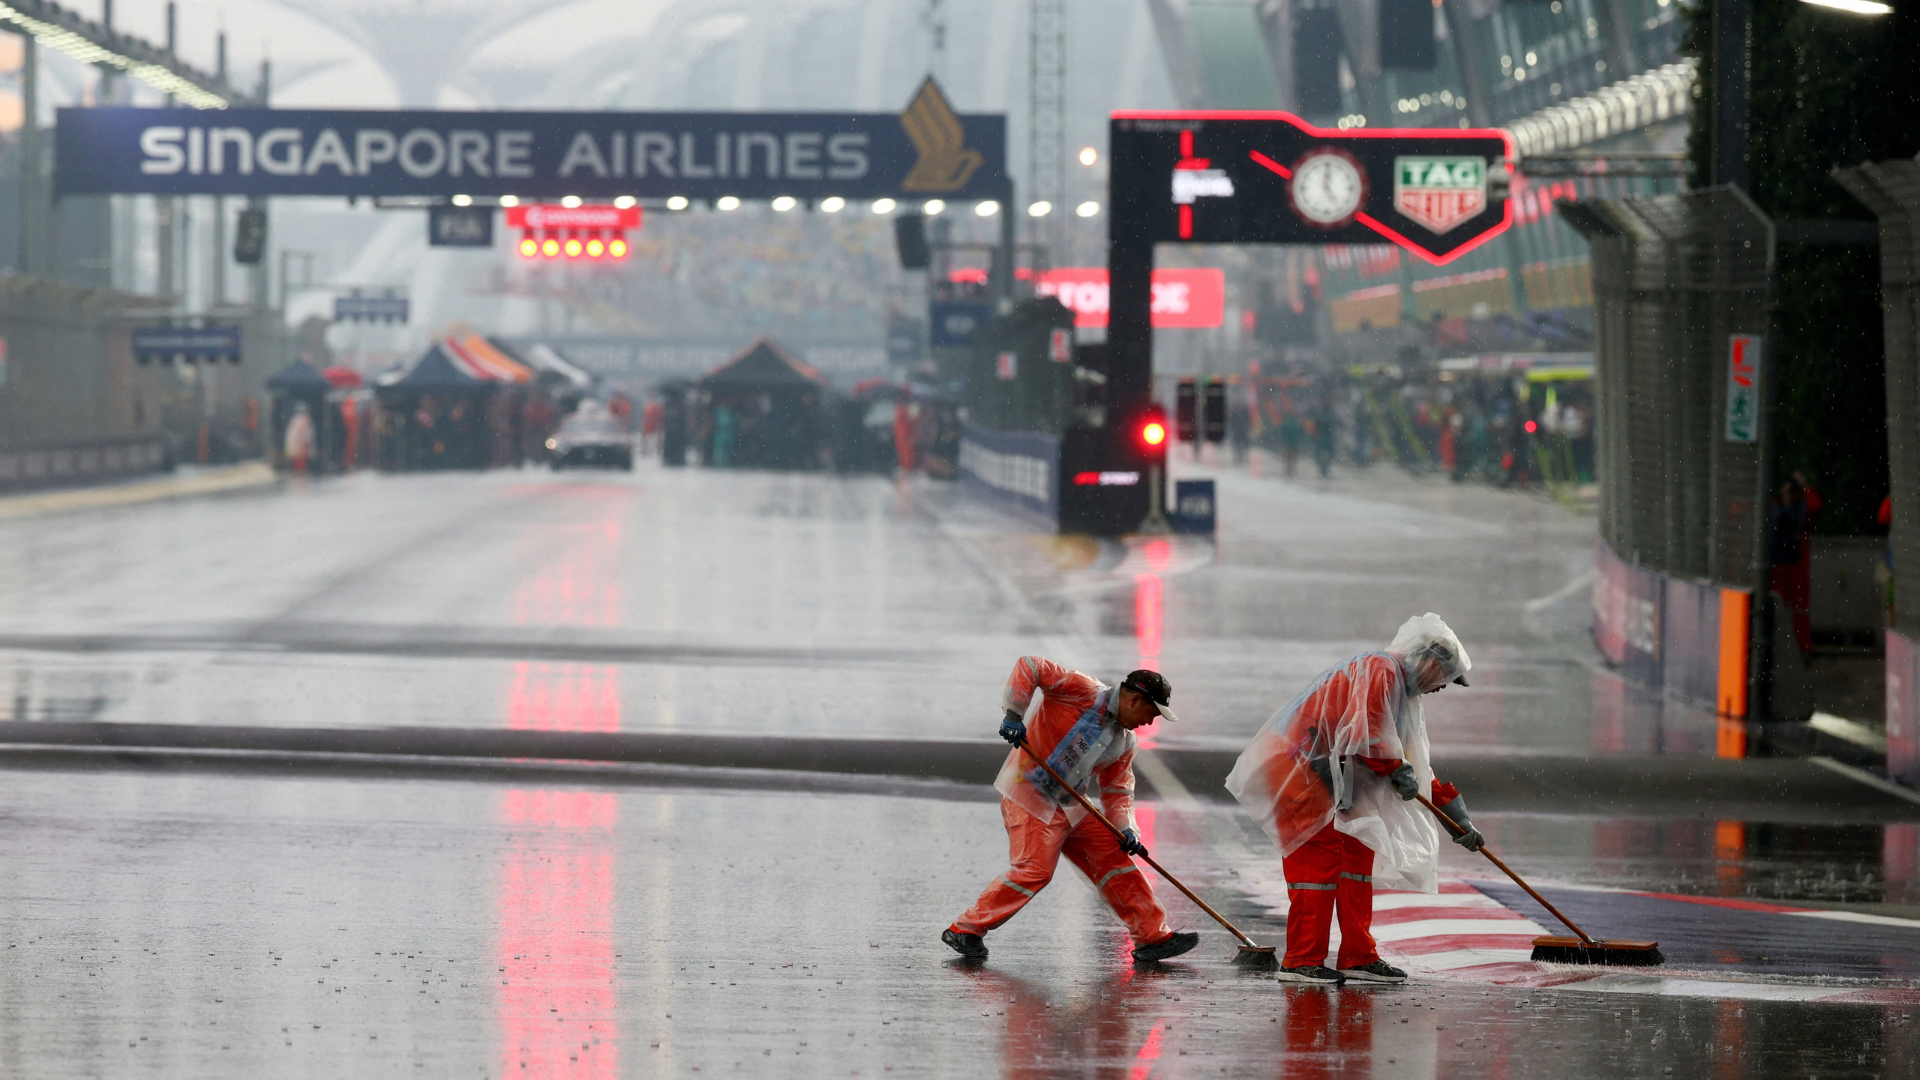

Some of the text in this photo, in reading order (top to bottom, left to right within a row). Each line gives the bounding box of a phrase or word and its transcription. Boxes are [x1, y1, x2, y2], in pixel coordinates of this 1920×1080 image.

[139, 125, 871, 180] SINGAPORE AIRLINES
[1402, 160, 1478, 187] TAG
